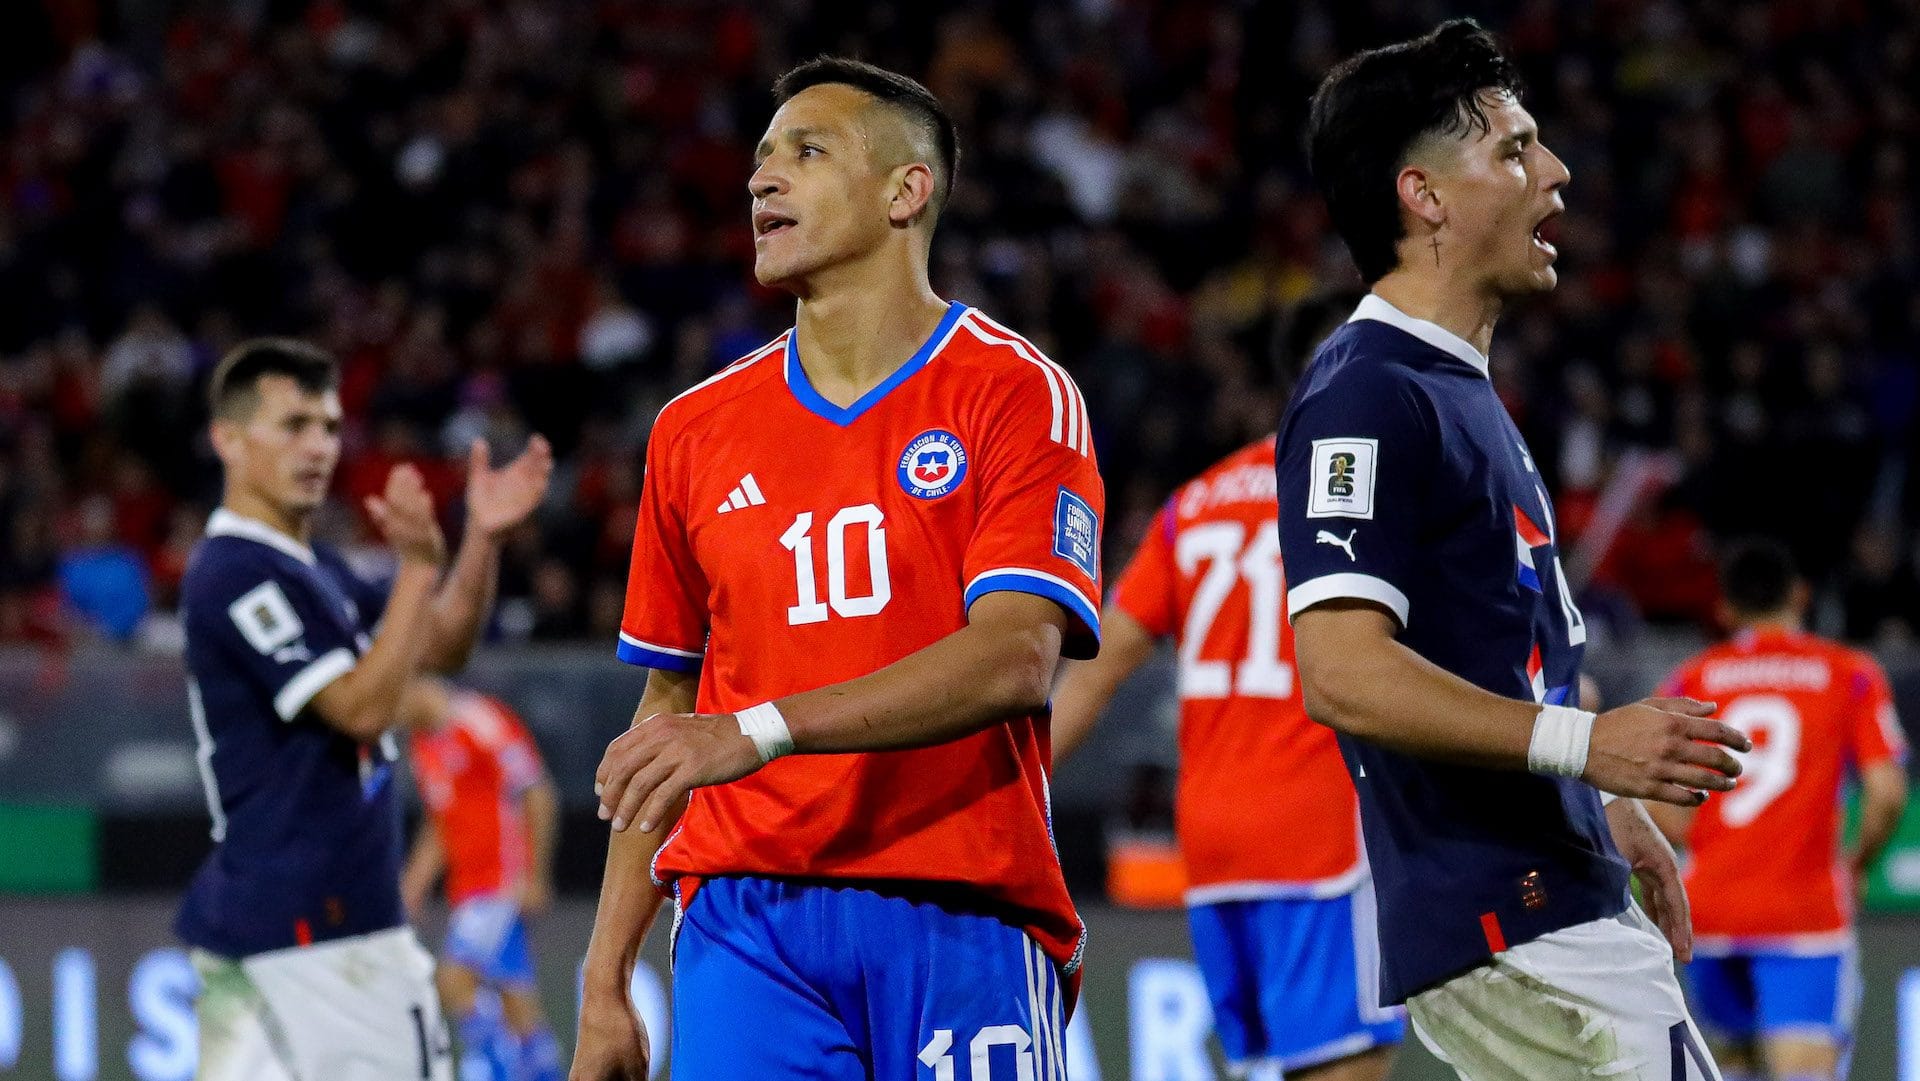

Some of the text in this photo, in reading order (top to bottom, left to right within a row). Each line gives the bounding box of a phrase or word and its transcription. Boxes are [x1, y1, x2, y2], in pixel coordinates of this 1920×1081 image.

[900, 434, 967, 469] FEDERACION DE FUTBOL
[911, 485, 949, 497] DE CHILE
[778, 502, 892, 627] 10
[1175, 519, 1294, 698] 21
[1720, 695, 1801, 829] 9
